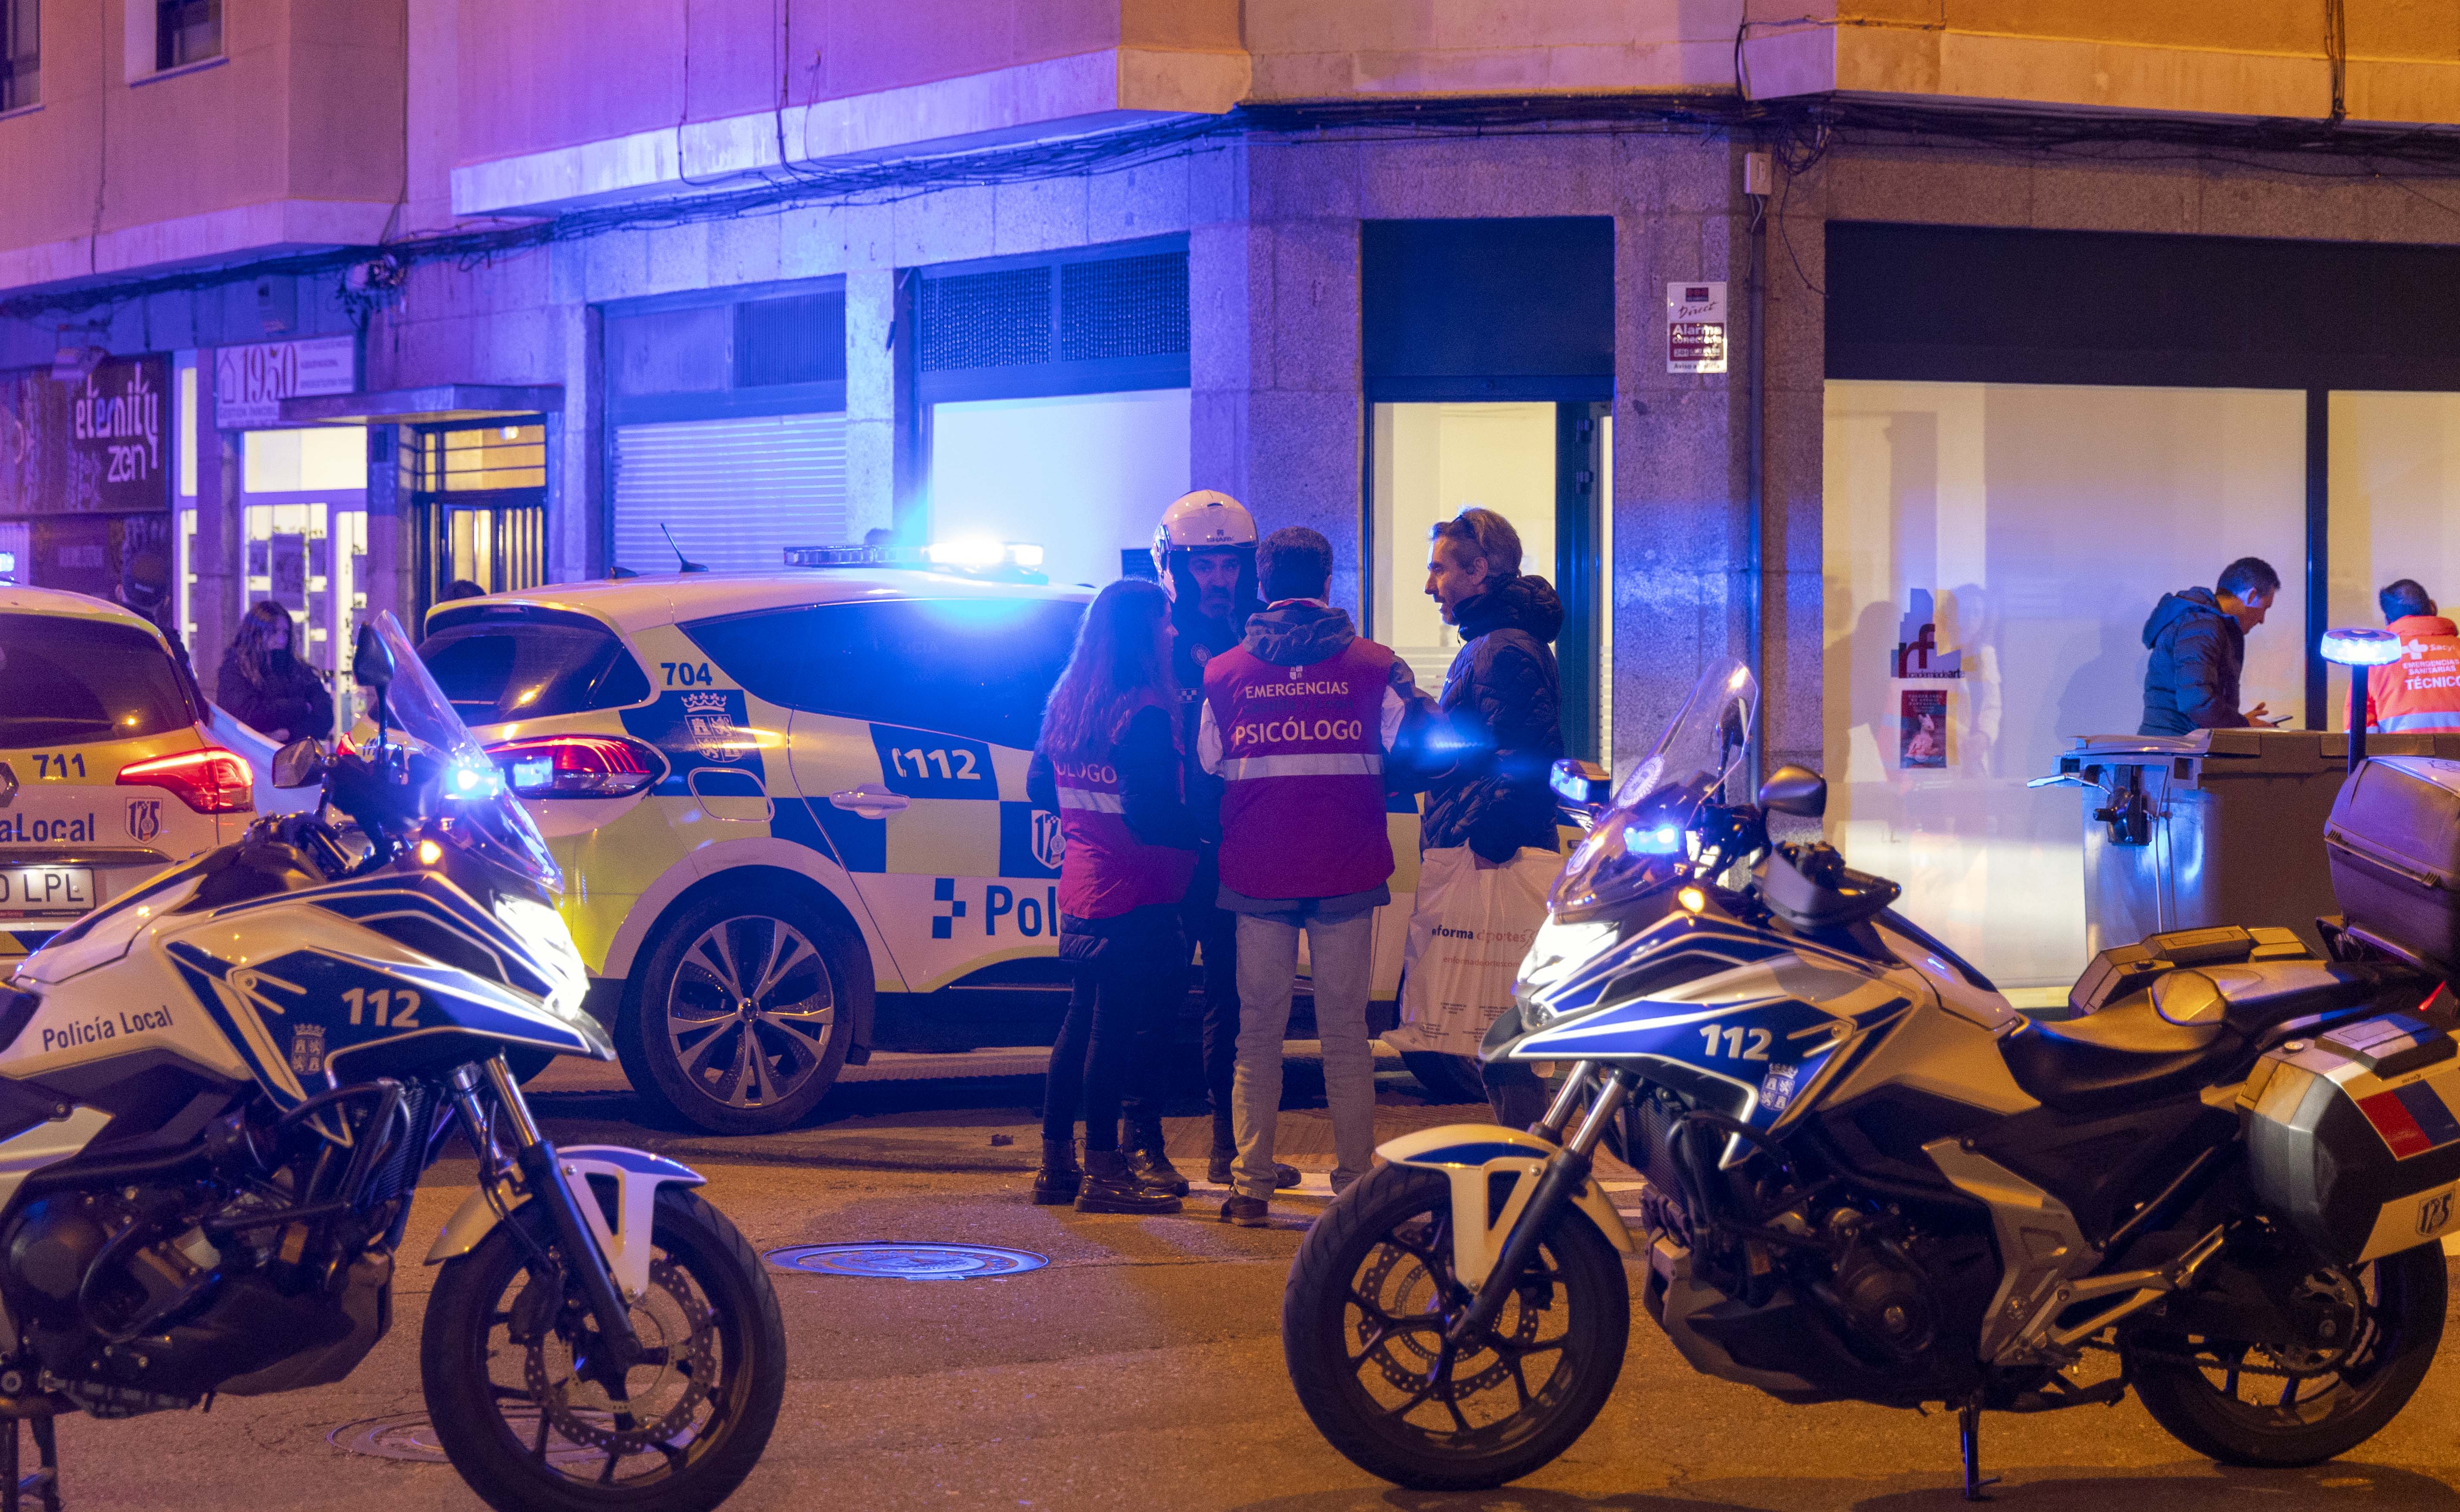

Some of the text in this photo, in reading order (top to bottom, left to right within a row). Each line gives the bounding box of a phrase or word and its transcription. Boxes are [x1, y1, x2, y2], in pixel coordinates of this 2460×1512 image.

[1672, 324, 1722, 335] Alarma
[242, 343, 297, 401] 1950
[76, 362, 158, 469] eternity
[108, 444, 146, 482] zen
[661, 663, 712, 686] 704
[1245, 681, 1349, 699] EMERGENCIAS
[1235, 716, 1362, 746] PSICÓLOGO
[32, 753, 85, 778] 711
[904, 749, 980, 780] 112
[0, 813, 94, 842] aLocal
[24, 874, 84, 902] LPL
[986, 885, 1058, 937] Pol
[341, 988, 421, 1028] 112
[43, 1005, 173, 1052] Policía Local
[1699, 1024, 1772, 1061] 112
